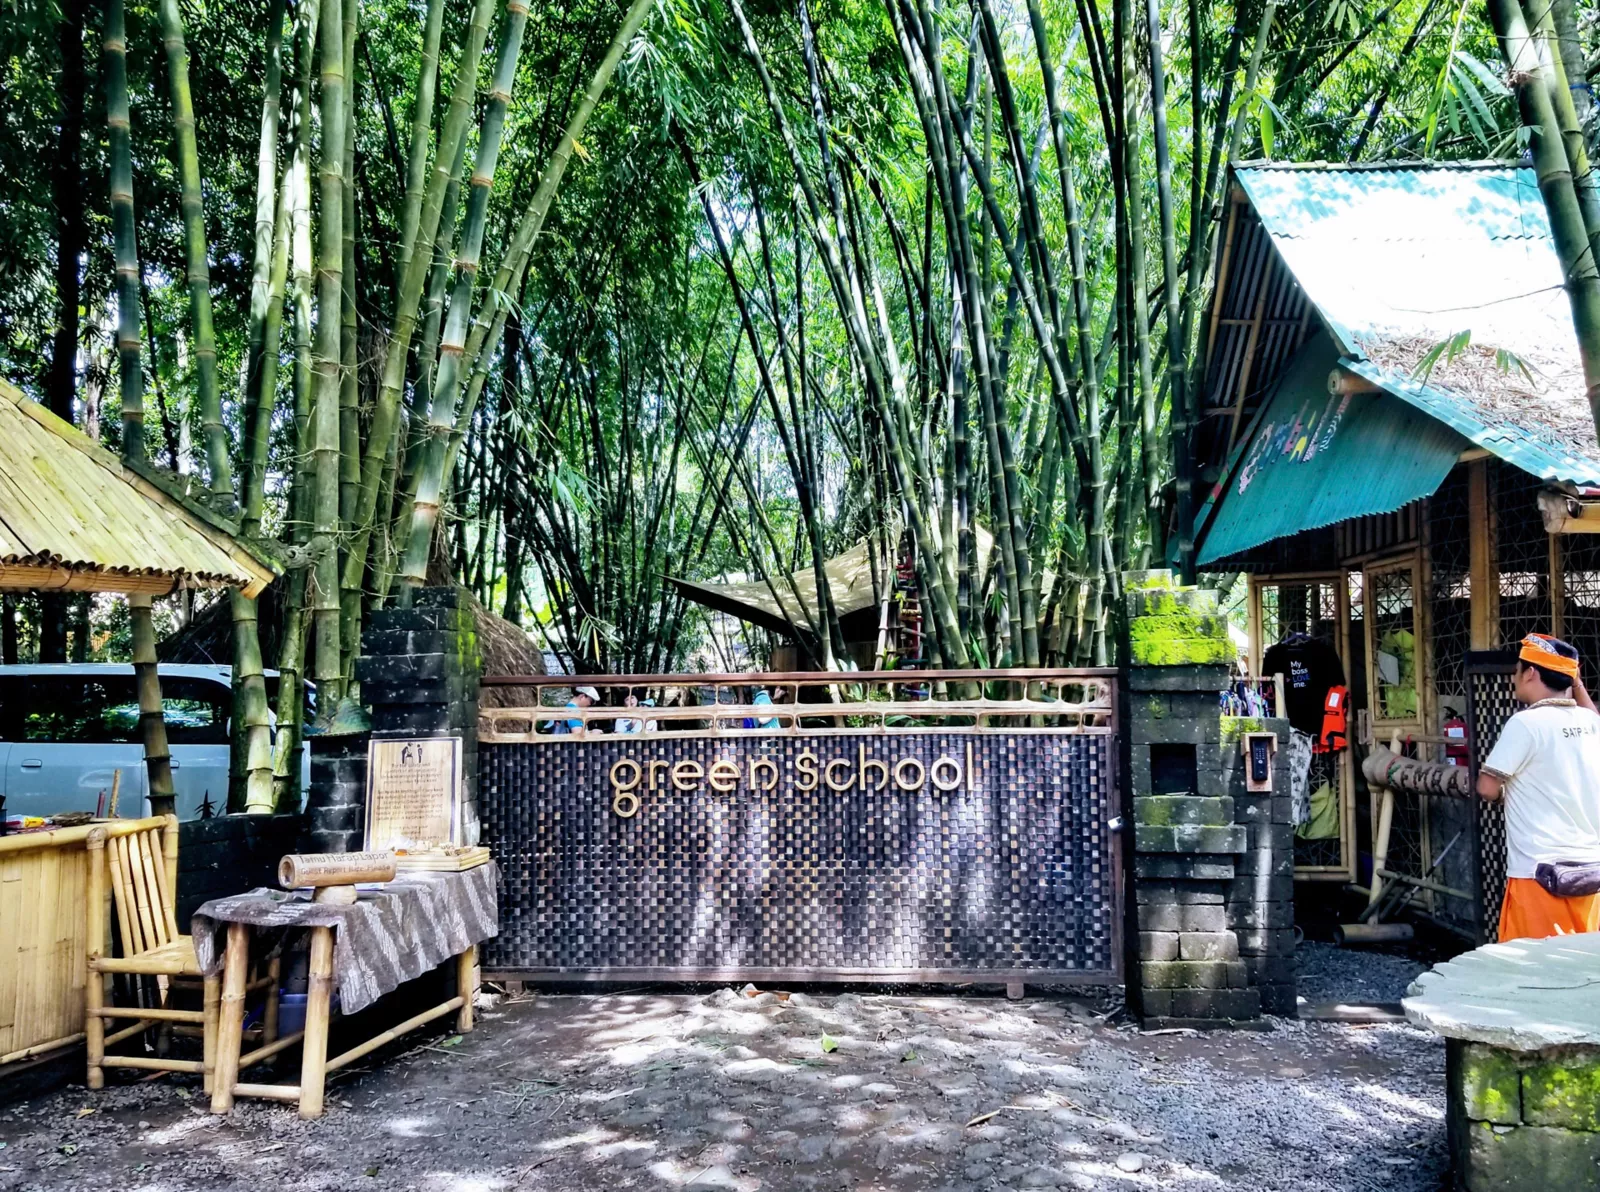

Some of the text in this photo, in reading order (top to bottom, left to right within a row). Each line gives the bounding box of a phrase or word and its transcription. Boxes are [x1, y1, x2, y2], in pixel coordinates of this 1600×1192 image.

[1290, 661, 1302, 669] My
[1292, 668, 1308, 676] boss
[609, 757, 779, 818] green
[299, 852, 389, 865] Tamu Harap Lapor
